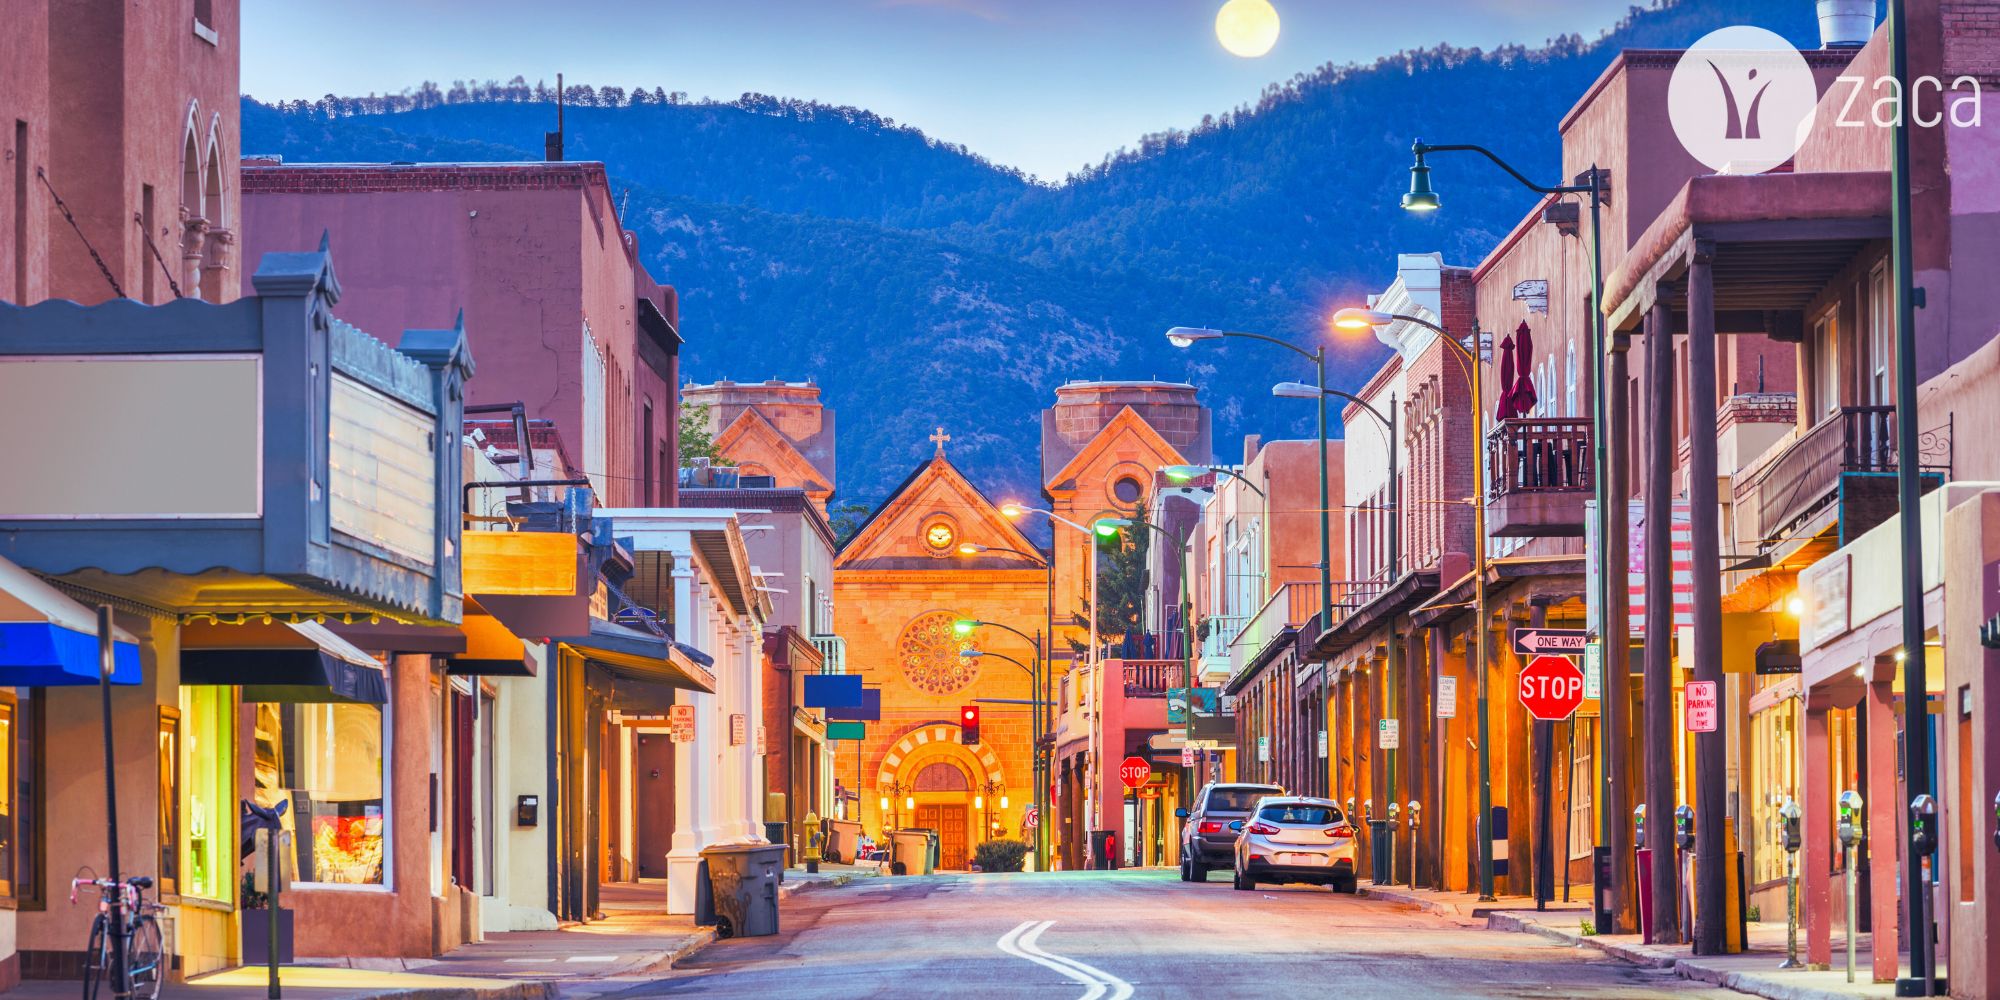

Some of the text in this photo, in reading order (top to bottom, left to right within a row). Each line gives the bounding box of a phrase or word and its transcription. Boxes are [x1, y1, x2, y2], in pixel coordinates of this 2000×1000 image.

[1537, 636, 1583, 647] ONE WAY
[1521, 675, 1582, 700] STOP
[1695, 687, 1707, 696] NO
[1688, 700, 1715, 709] PARKING
[1380, 721, 1386, 729] 2
[1121, 766, 1149, 778] STOP
